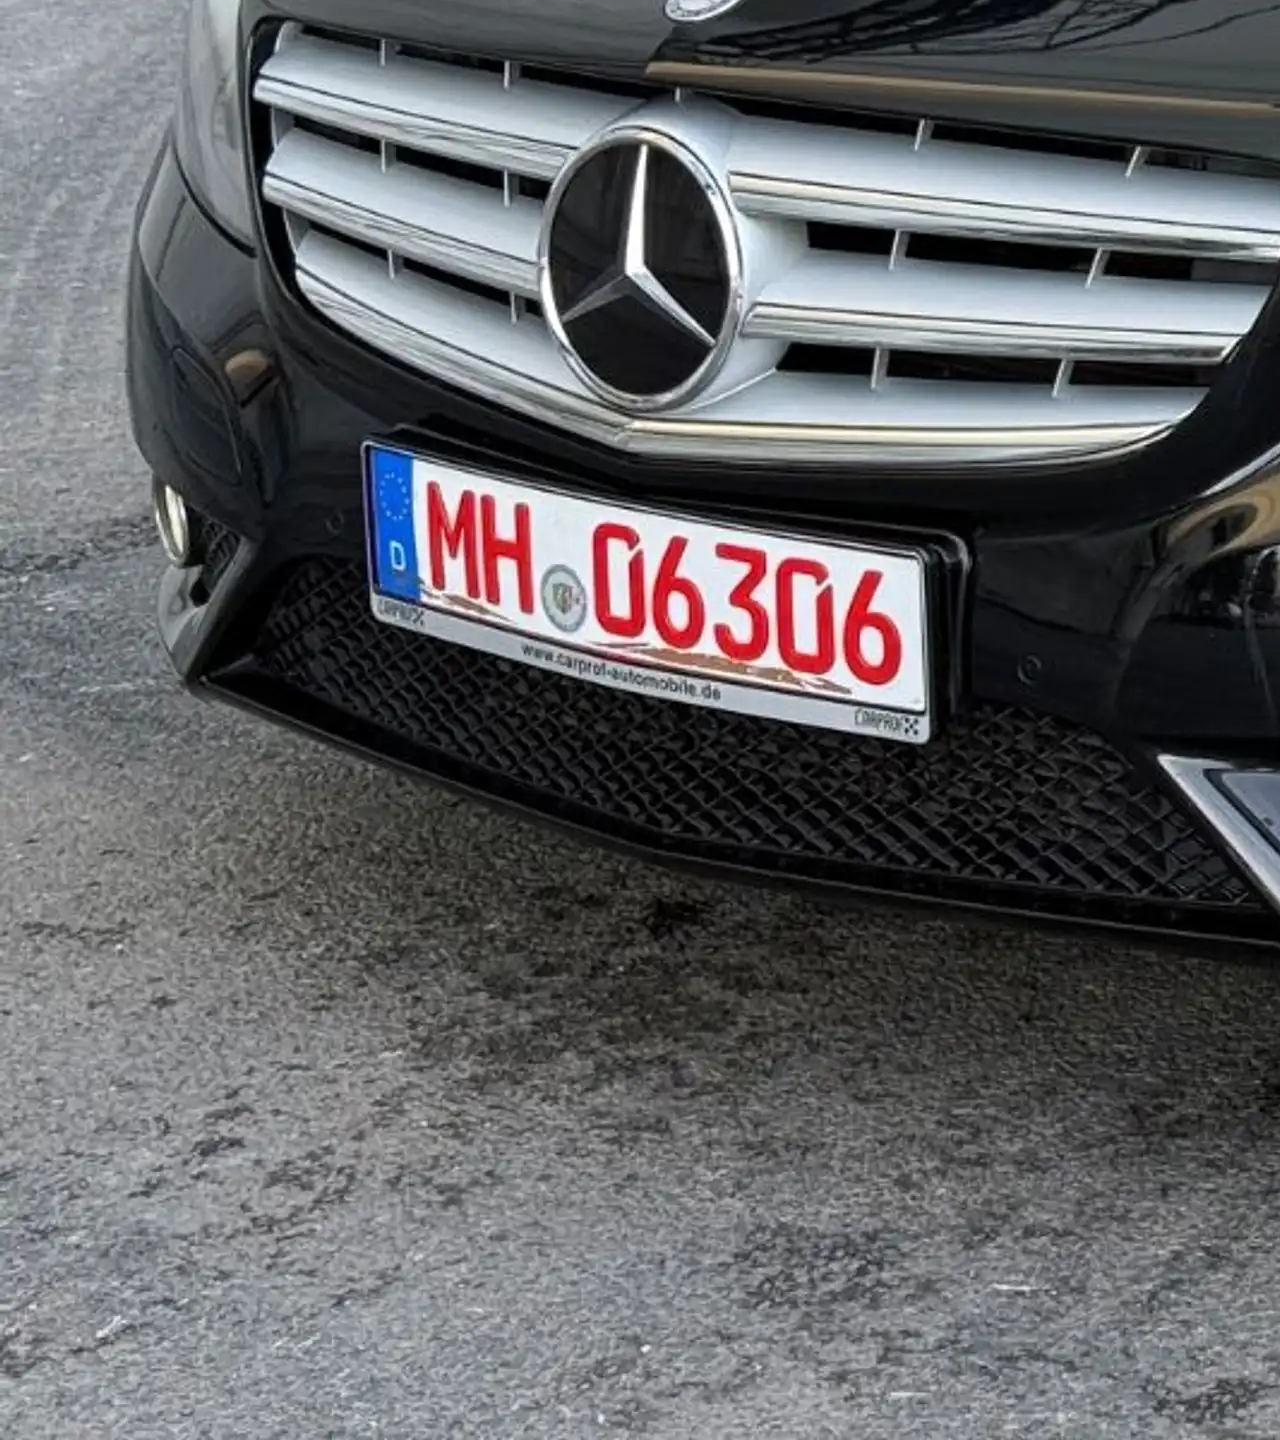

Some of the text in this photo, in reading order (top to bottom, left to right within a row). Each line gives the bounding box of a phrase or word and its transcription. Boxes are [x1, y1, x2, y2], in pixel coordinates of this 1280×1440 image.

[389, 539, 407, 571] D
[426, 479, 902, 687] MH 06306
[520, 641, 721, 701] www.carprof-automobile.de
